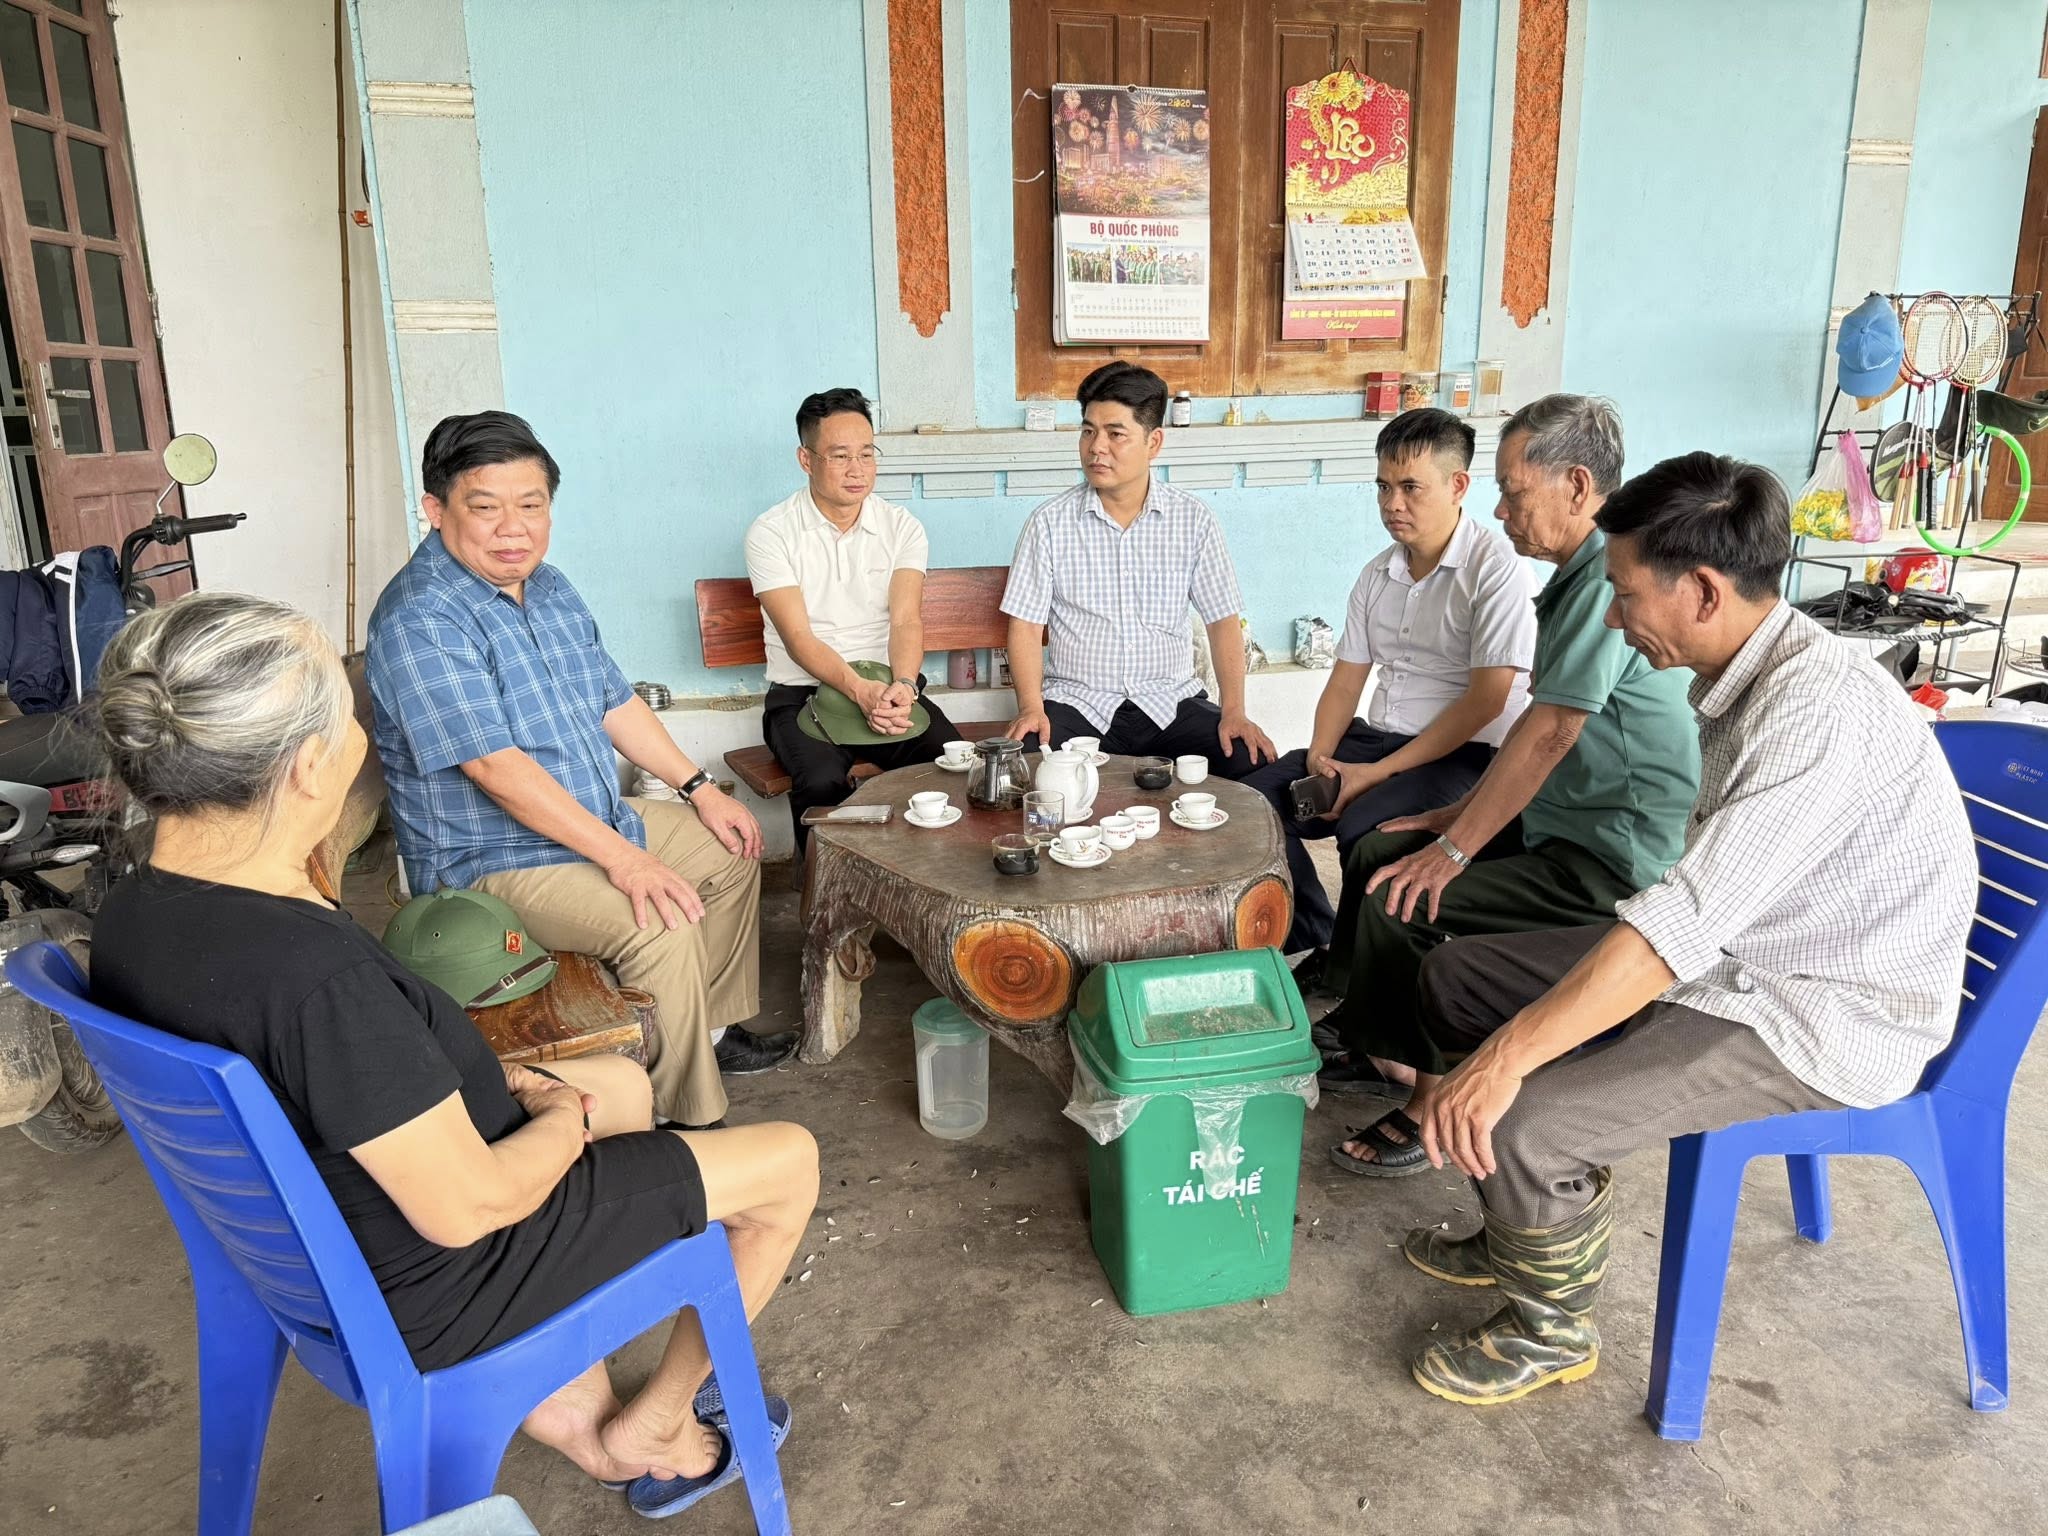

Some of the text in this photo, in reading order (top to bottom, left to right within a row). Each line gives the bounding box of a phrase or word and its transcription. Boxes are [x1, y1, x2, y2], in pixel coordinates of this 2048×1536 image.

[1090, 219, 1179, 238] BỘ QUỐC PHÒNG
[1189, 1143, 1246, 1170] RÁC
[1162, 1166, 1265, 1206] TÁI CHẾ
